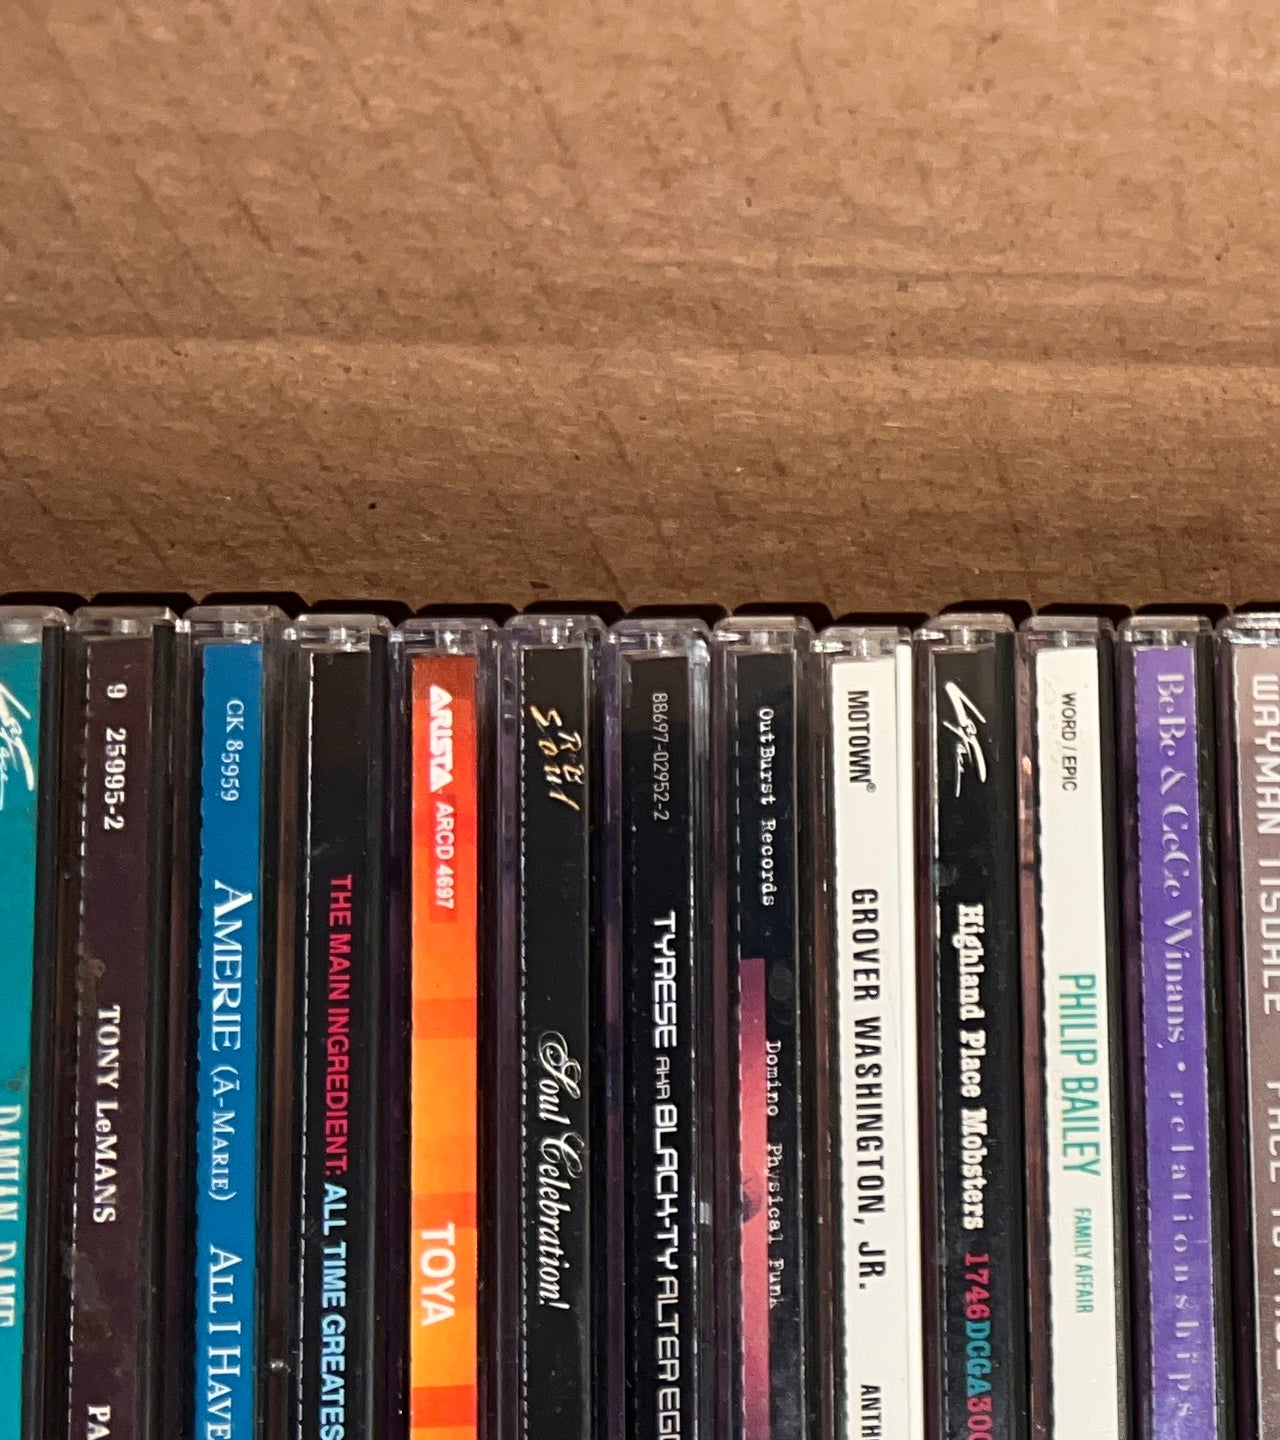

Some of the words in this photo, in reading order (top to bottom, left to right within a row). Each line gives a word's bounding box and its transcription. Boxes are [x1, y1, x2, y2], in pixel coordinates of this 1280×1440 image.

[429, 685, 454, 793] ARISTA
[650, 692, 671, 821] 88697-02952-2
[1061, 692, 1079, 743] WORD
[102, 728, 126, 830] 25995-2
[218, 740, 243, 801] 85959
[1061, 756, 1079, 791] EPIC
[434, 803, 453, 859] ARCD
[759, 819, 778, 907] Records
[434, 865, 454, 908] 4697
[327, 934, 351, 1000] MAIN
[652, 910, 677, 1048] TYRESE
[851, 889, 879, 1002] GROVER
[955, 904, 984, 1021] Highland
[1162, 910, 1194, 1044] Winans
[95, 1005, 121, 1086] TONY
[958, 1029, 983, 1097] Place
[1059, 973, 1097, 1066] PHILIP
[324, 1007, 351, 1176] INGREDIENT:
[852, 1017, 886, 1226] WASHINGTON,
[1060, 1076, 1101, 1176] BAILEY
[91, 1100, 118, 1223] LeMANS
[958, 1108, 988, 1229] Mobsters
[537, 1131, 585, 1308] Celebration!
[1072, 1207, 1093, 1259] FAMILY
[320, 1241, 345, 1308] TIME
[420, 1223, 456, 1326] TOYA
[1074, 1264, 1095, 1314] AFFAIR
[656, 1276, 678, 1381] ALTER
